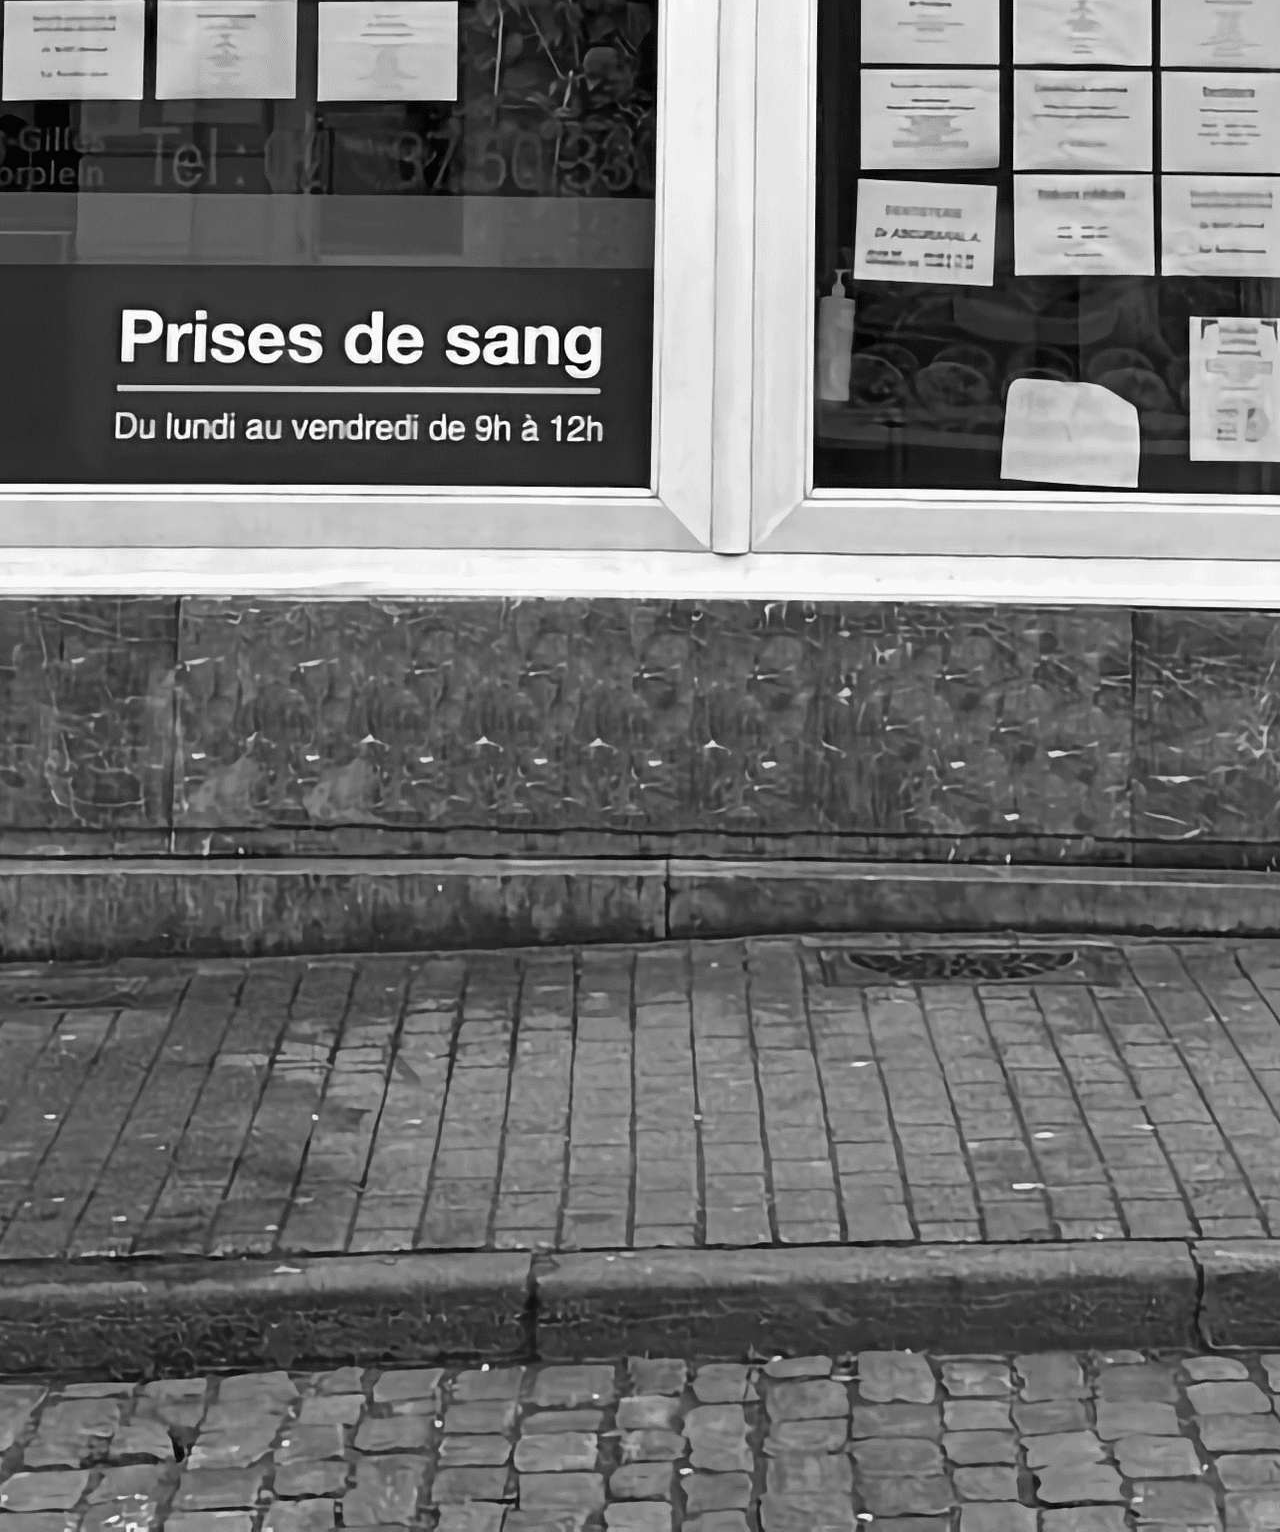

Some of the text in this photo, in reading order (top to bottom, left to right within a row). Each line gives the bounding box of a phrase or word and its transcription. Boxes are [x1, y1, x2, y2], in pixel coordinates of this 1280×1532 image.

[120, 309, 602, 379] Prises de sang
[115, 412, 604, 443] Du lundi au vendredi de 9h à 12h
